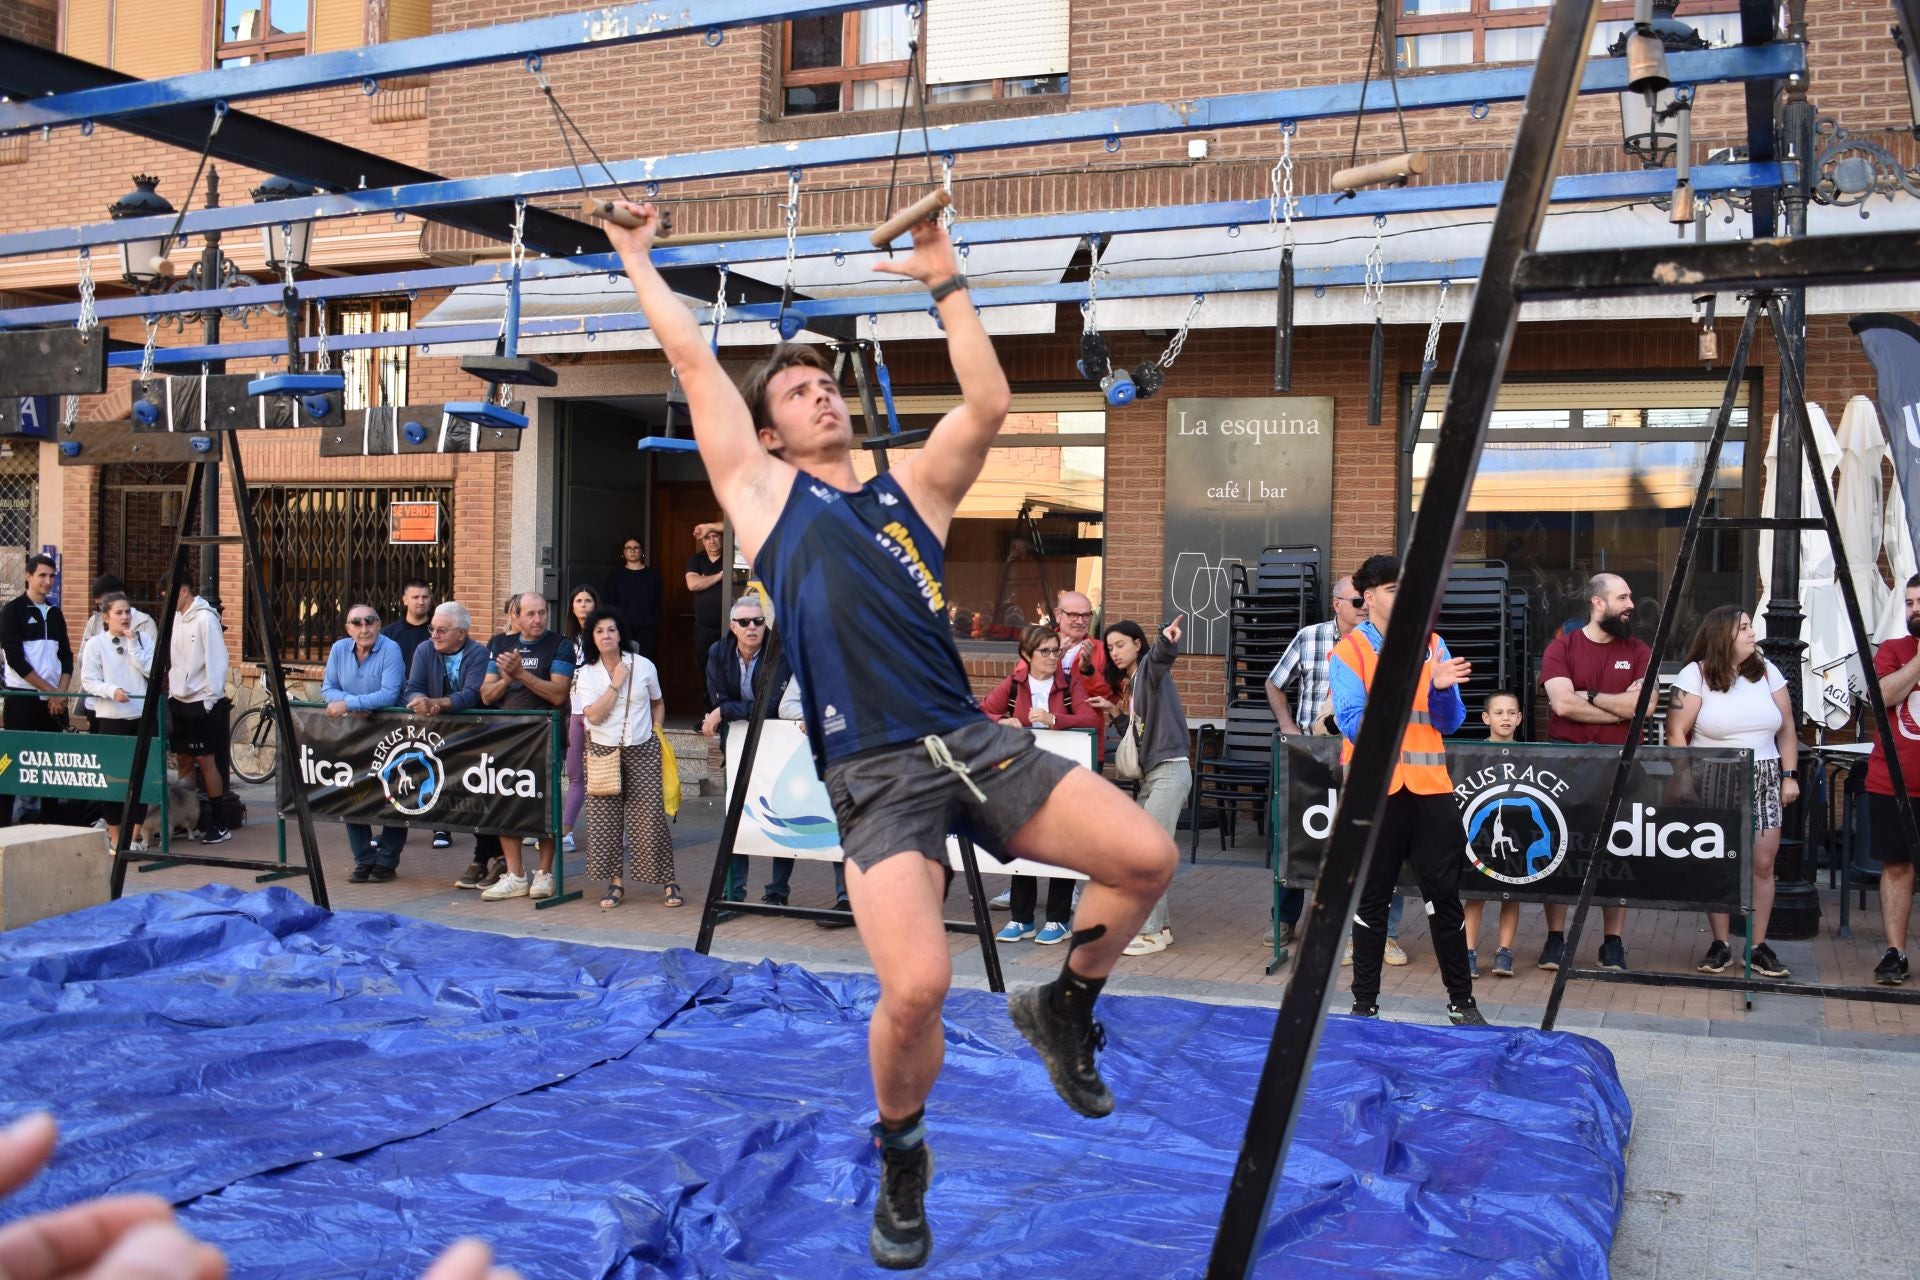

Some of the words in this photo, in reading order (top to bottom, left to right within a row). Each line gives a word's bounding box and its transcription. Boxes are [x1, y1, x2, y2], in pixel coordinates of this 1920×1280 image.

[1178, 411, 1208, 435] La
[1220, 412, 1320, 445] esquina
[1207, 480, 1240, 498] café
[1260, 480, 1288, 498] bar
[393, 505, 402, 517] SE
[405, 505, 435, 517] VENDE
[19, 750, 52, 767] CAJA
[54, 752, 101, 769] RURAL
[366, 728, 404, 777] IBERUS
[406, 725, 446, 751] RACE
[19, 769, 39, 784] DE
[42, 770, 108, 788] NAVARRA
[1502, 763, 1570, 798] RACE
[1606, 803, 1725, 859] dica
